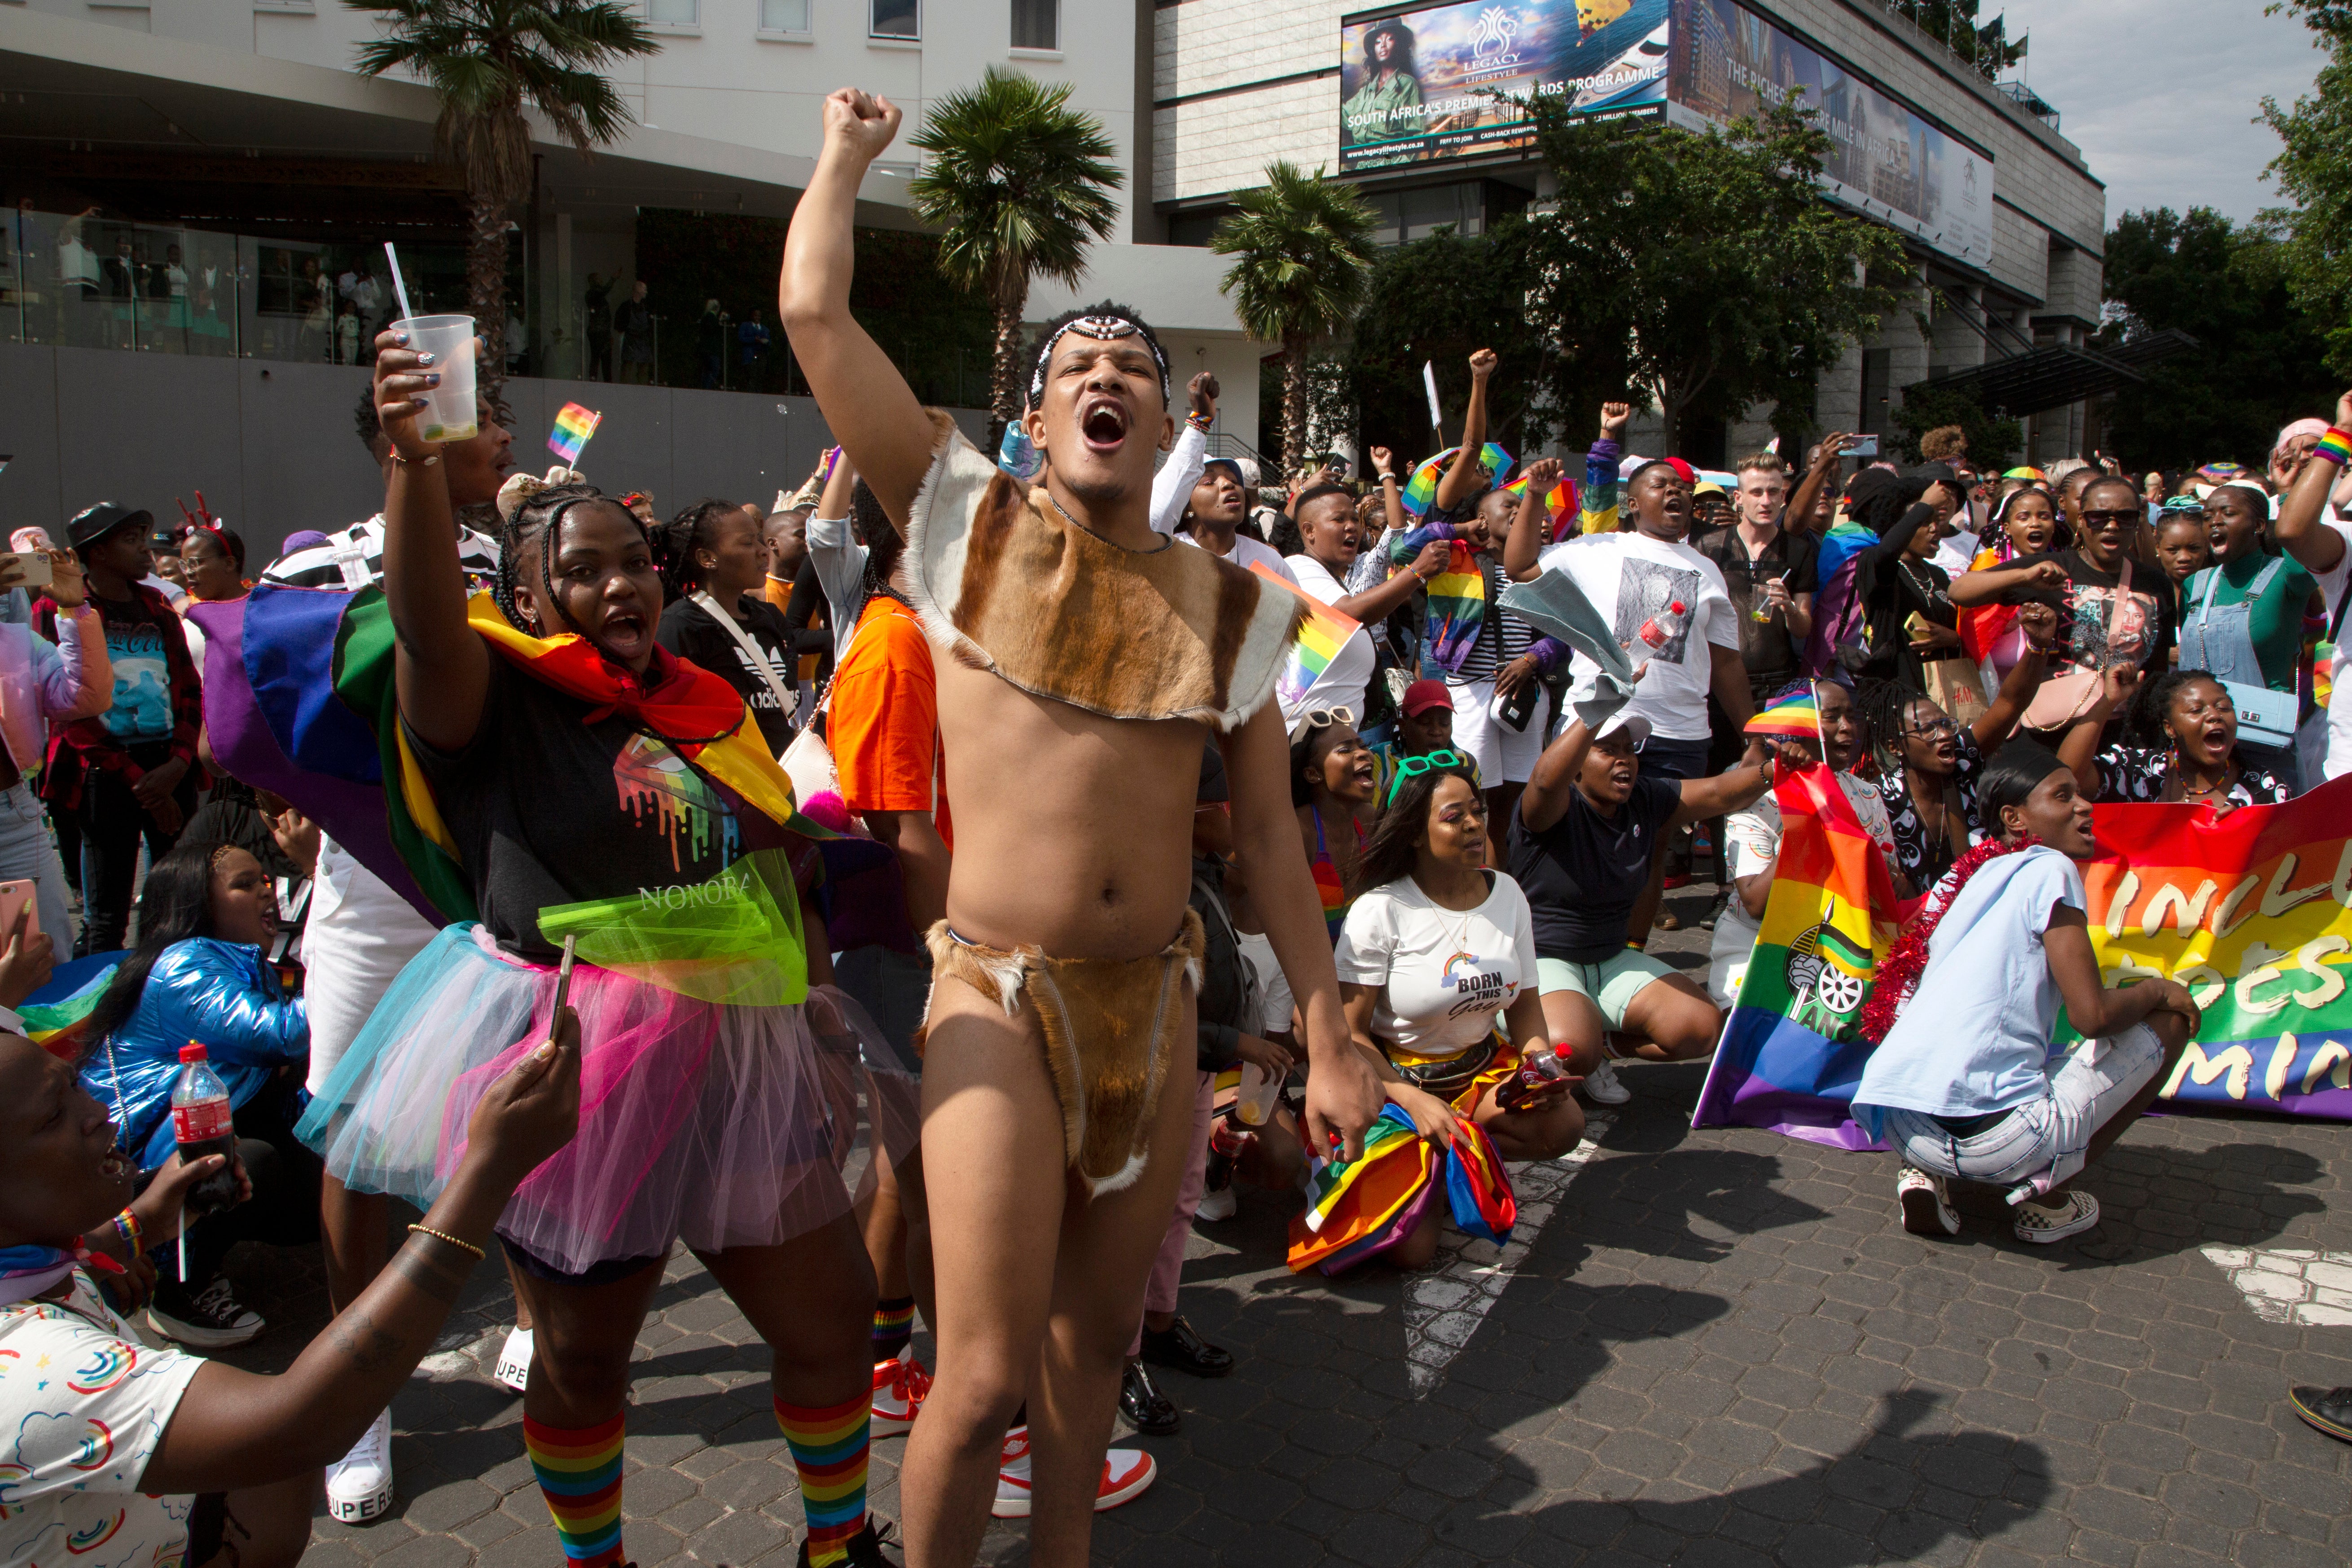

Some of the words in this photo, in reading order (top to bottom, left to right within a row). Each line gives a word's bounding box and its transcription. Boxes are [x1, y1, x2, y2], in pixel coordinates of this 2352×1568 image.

[1464, 53, 1520, 71] LEGACY
[1466, 69, 1517, 84] LIFESTYLE
[1347, 110, 1387, 128] SOUTH
[1567, 66, 1660, 92] PROGRAMME
[1726, 57, 1747, 87] THE
[1751, 70, 1788, 107] RICHES
[1832, 117, 1853, 145] MILE
[1856, 130, 1865, 151] IN
[1347, 141, 1424, 158] www.legacylifestyle.co.za
[1461, 135, 1473, 143] JOIN
[1481, 129, 1511, 139] CASH-BACK
[1511, 125, 1537, 135] REWARDS
[1602, 112, 1627, 121] MILLION
[1458, 971, 1503, 994] BORN
[1475, 988, 1501, 1001] THIS
[1448, 996, 1500, 1021] Gay
[1799, 1005, 1856, 1044] ANC
[497, 1360, 527, 1384] UPE
